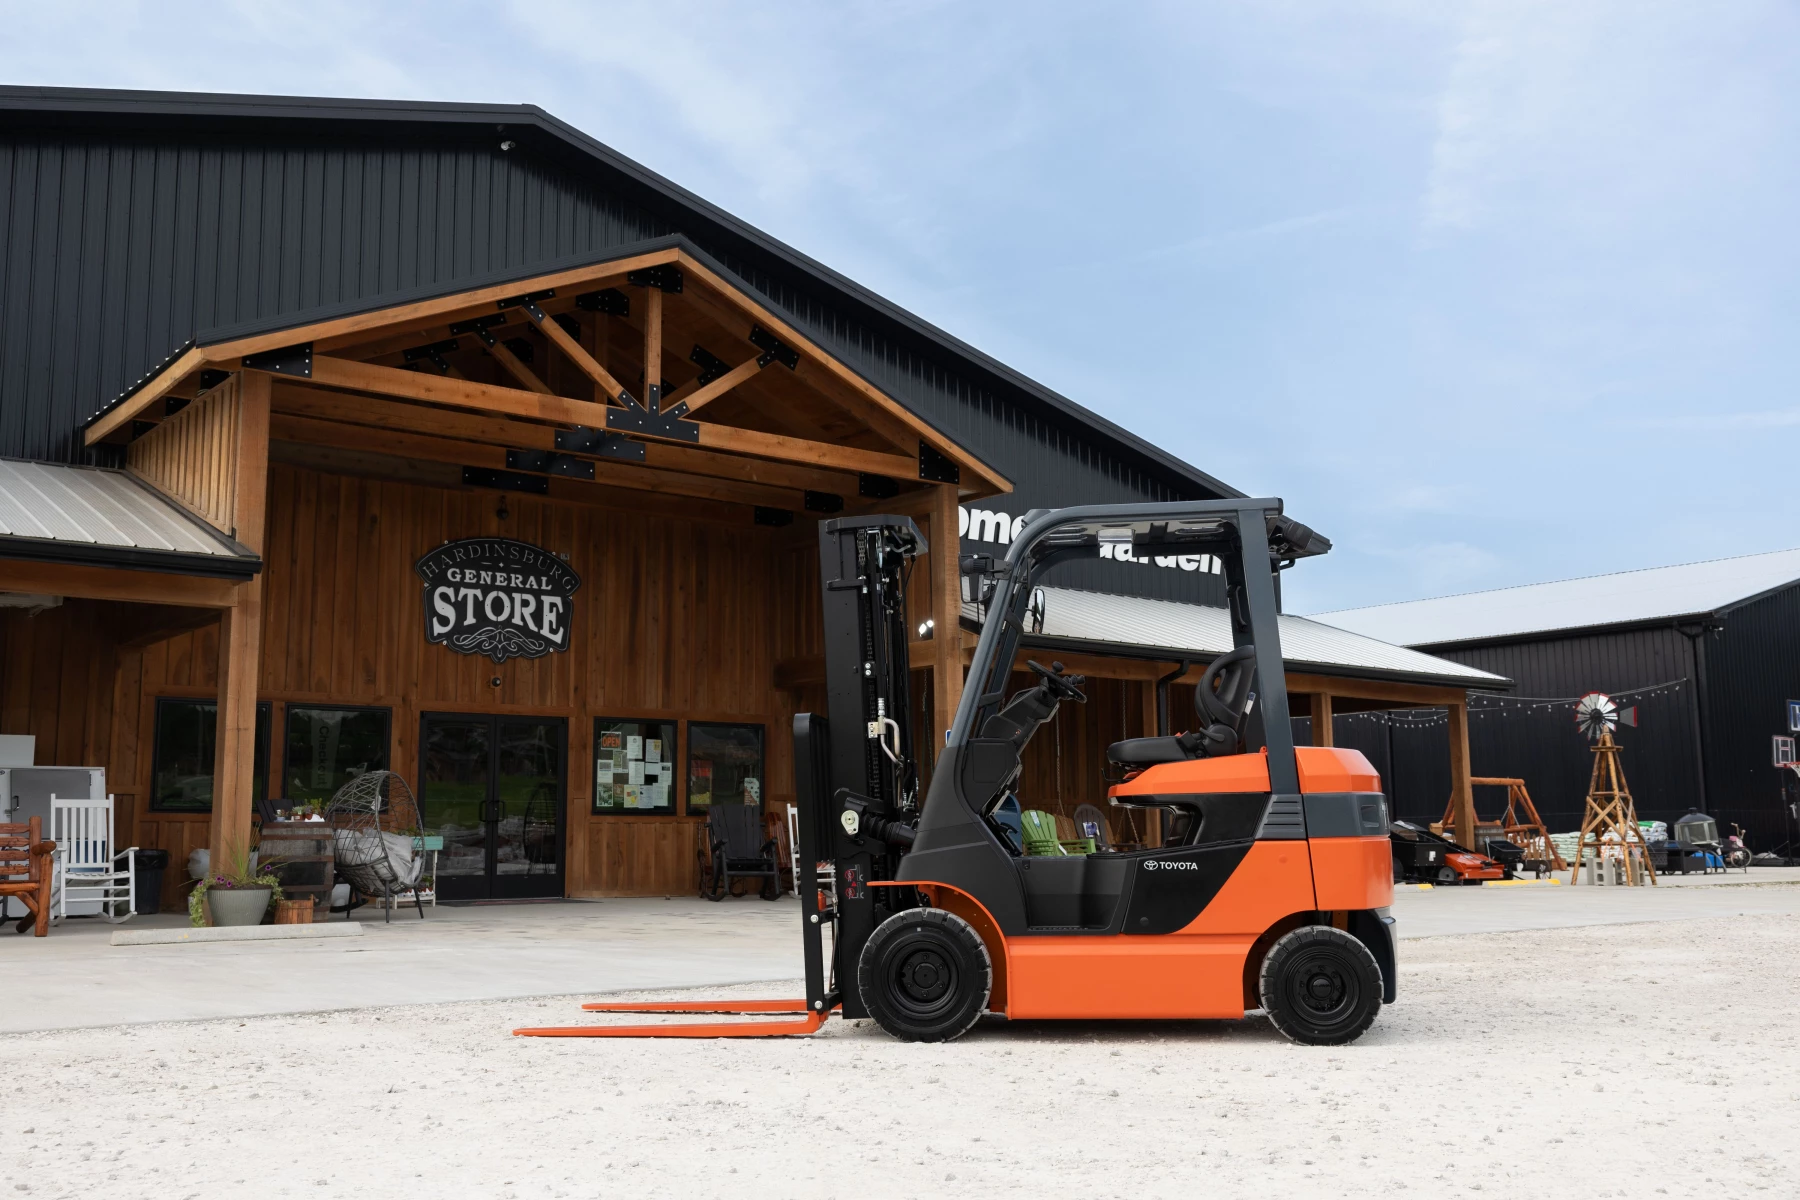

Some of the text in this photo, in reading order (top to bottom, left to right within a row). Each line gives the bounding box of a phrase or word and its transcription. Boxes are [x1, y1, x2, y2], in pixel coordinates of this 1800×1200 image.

[423, 543, 575, 590] HARDINSBURG
[447, 567, 552, 590] GENERAL
[432, 585, 564, 644] STORE
[316, 726, 330, 786] Checkout
[602, 736, 620, 747] OPEN
[1159, 862, 1198, 870] TOYOTA
